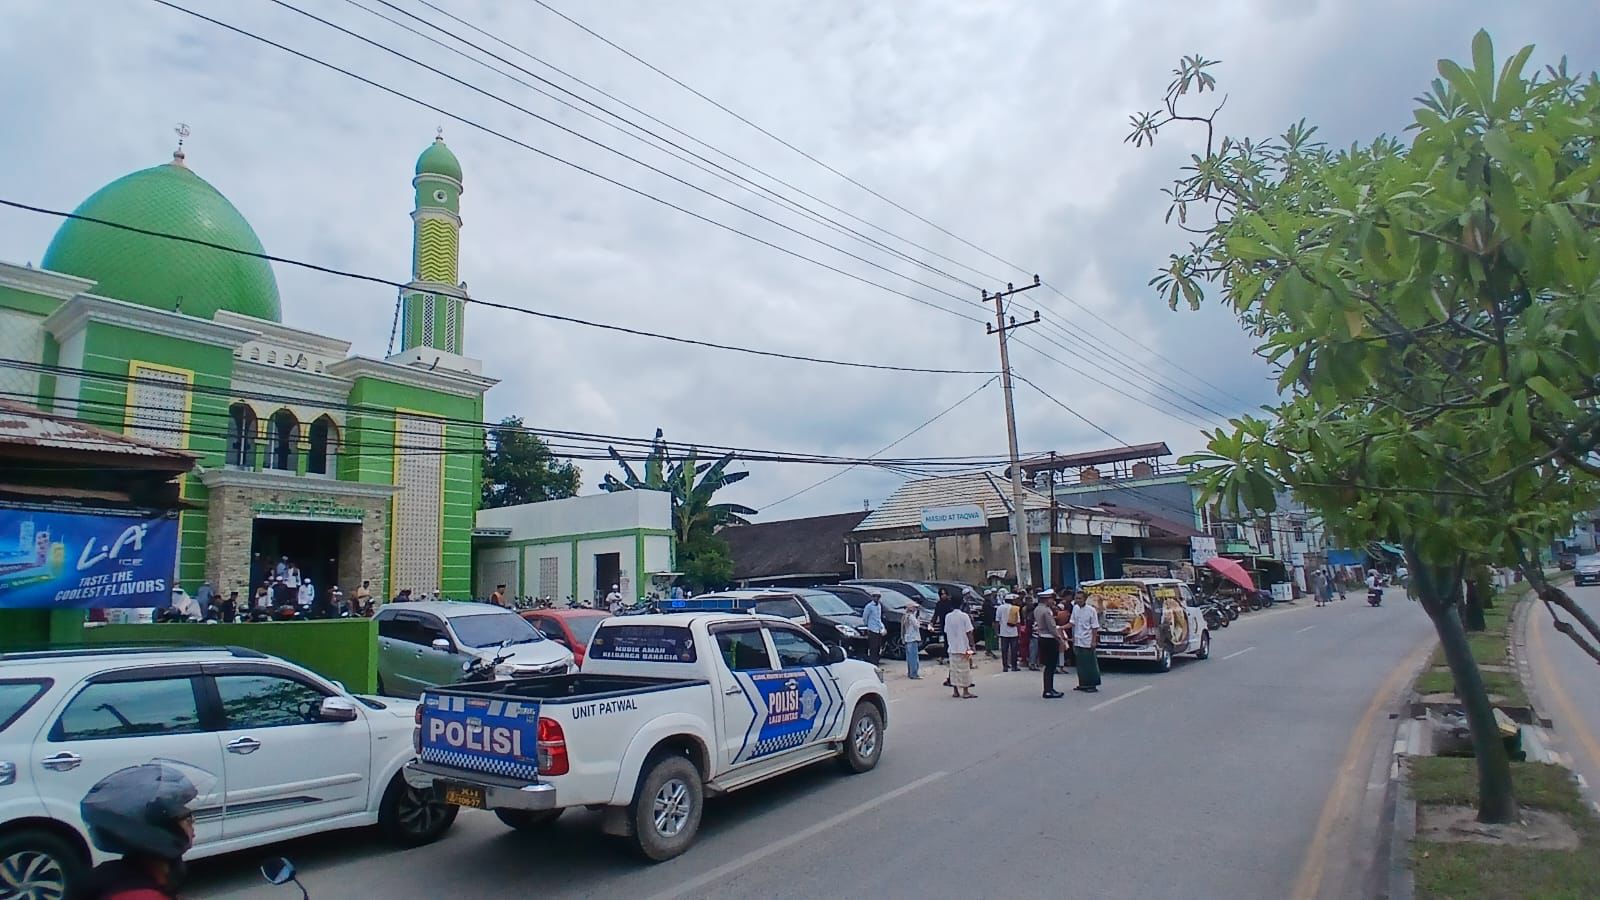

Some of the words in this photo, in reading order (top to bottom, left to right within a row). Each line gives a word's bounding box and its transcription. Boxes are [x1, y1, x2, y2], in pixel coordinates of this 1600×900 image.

[957, 512, 979, 520] TAQWA
[79, 574, 110, 587] TASTE
[111, 571, 133, 582] THE
[55, 585, 105, 601] COOLEST
[105, 579, 165, 596] FLAVORS
[572, 704, 596, 719] UNIT
[599, 698, 638, 715] PATWAL
[769, 690, 799, 714] POLISI
[430, 718, 521, 756] POLISI
